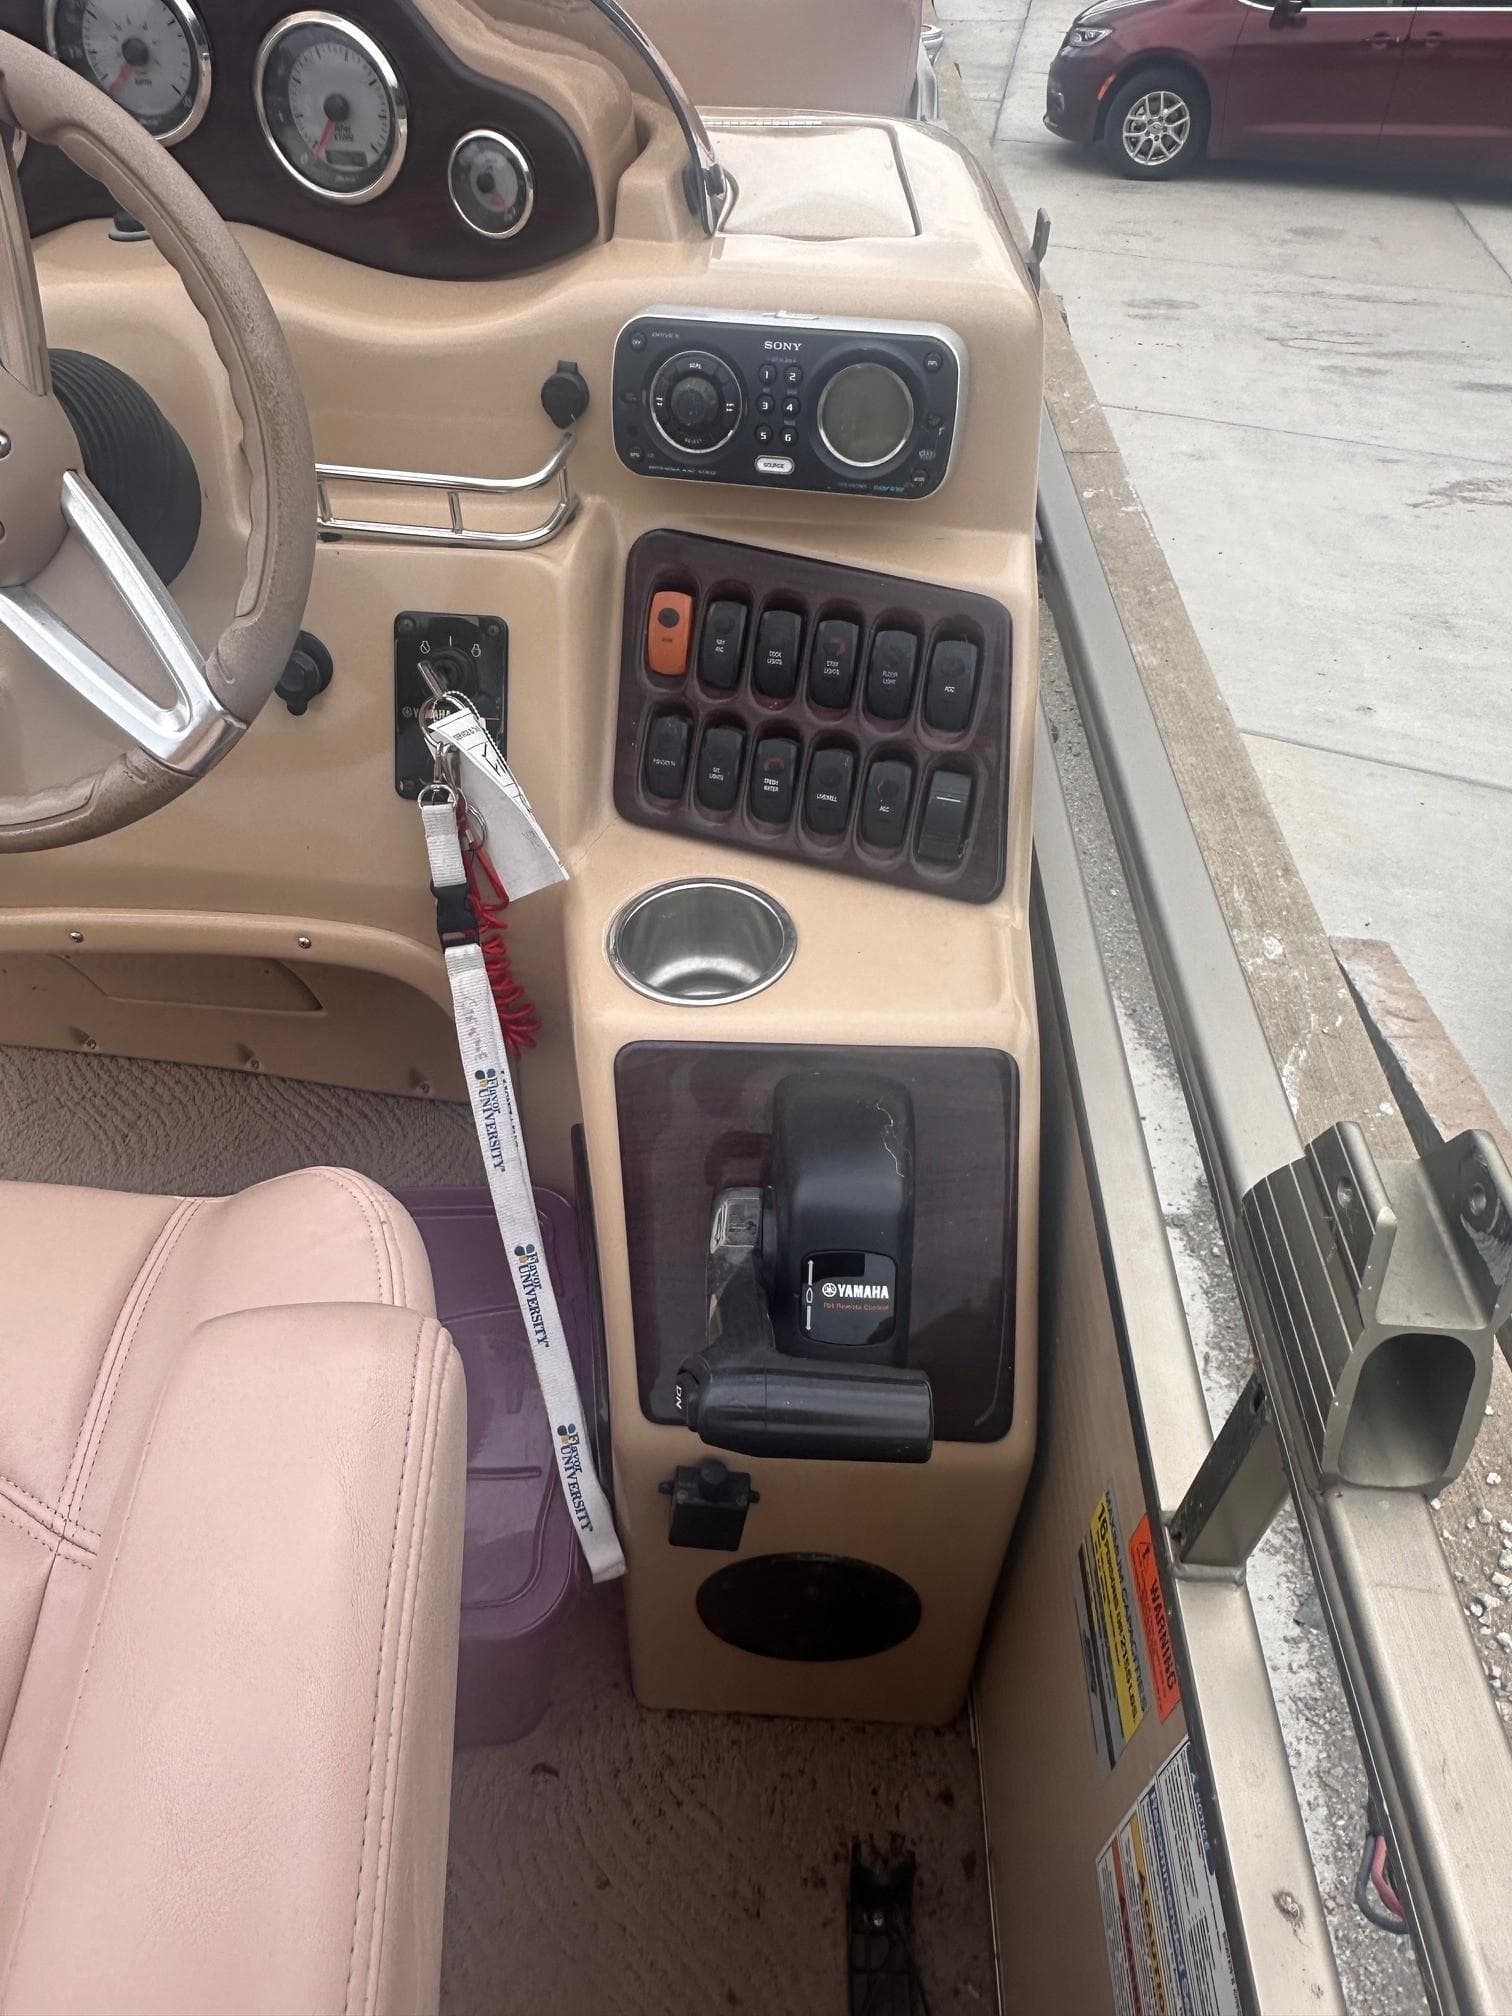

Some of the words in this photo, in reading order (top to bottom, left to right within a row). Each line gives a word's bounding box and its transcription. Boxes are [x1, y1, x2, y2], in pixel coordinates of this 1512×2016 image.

[764, 341, 802, 351] SONY
[765, 370, 769, 379] 1
[789, 372, 796, 381] 2
[762, 402, 768, 410] 3
[786, 403, 793, 412] 4
[760, 432, 767, 440] 5
[785, 434, 791, 442] 6
[487, 1077, 501, 1114] Flavor
[527, 1252, 542, 1290] Flavor
[838, 1284, 889, 1299] YAMAHA
[569, 1432, 582, 1473] Flavor
[1098, 1502, 1108, 1541] 16
[1151, 1578, 1177, 1691] WARNING
